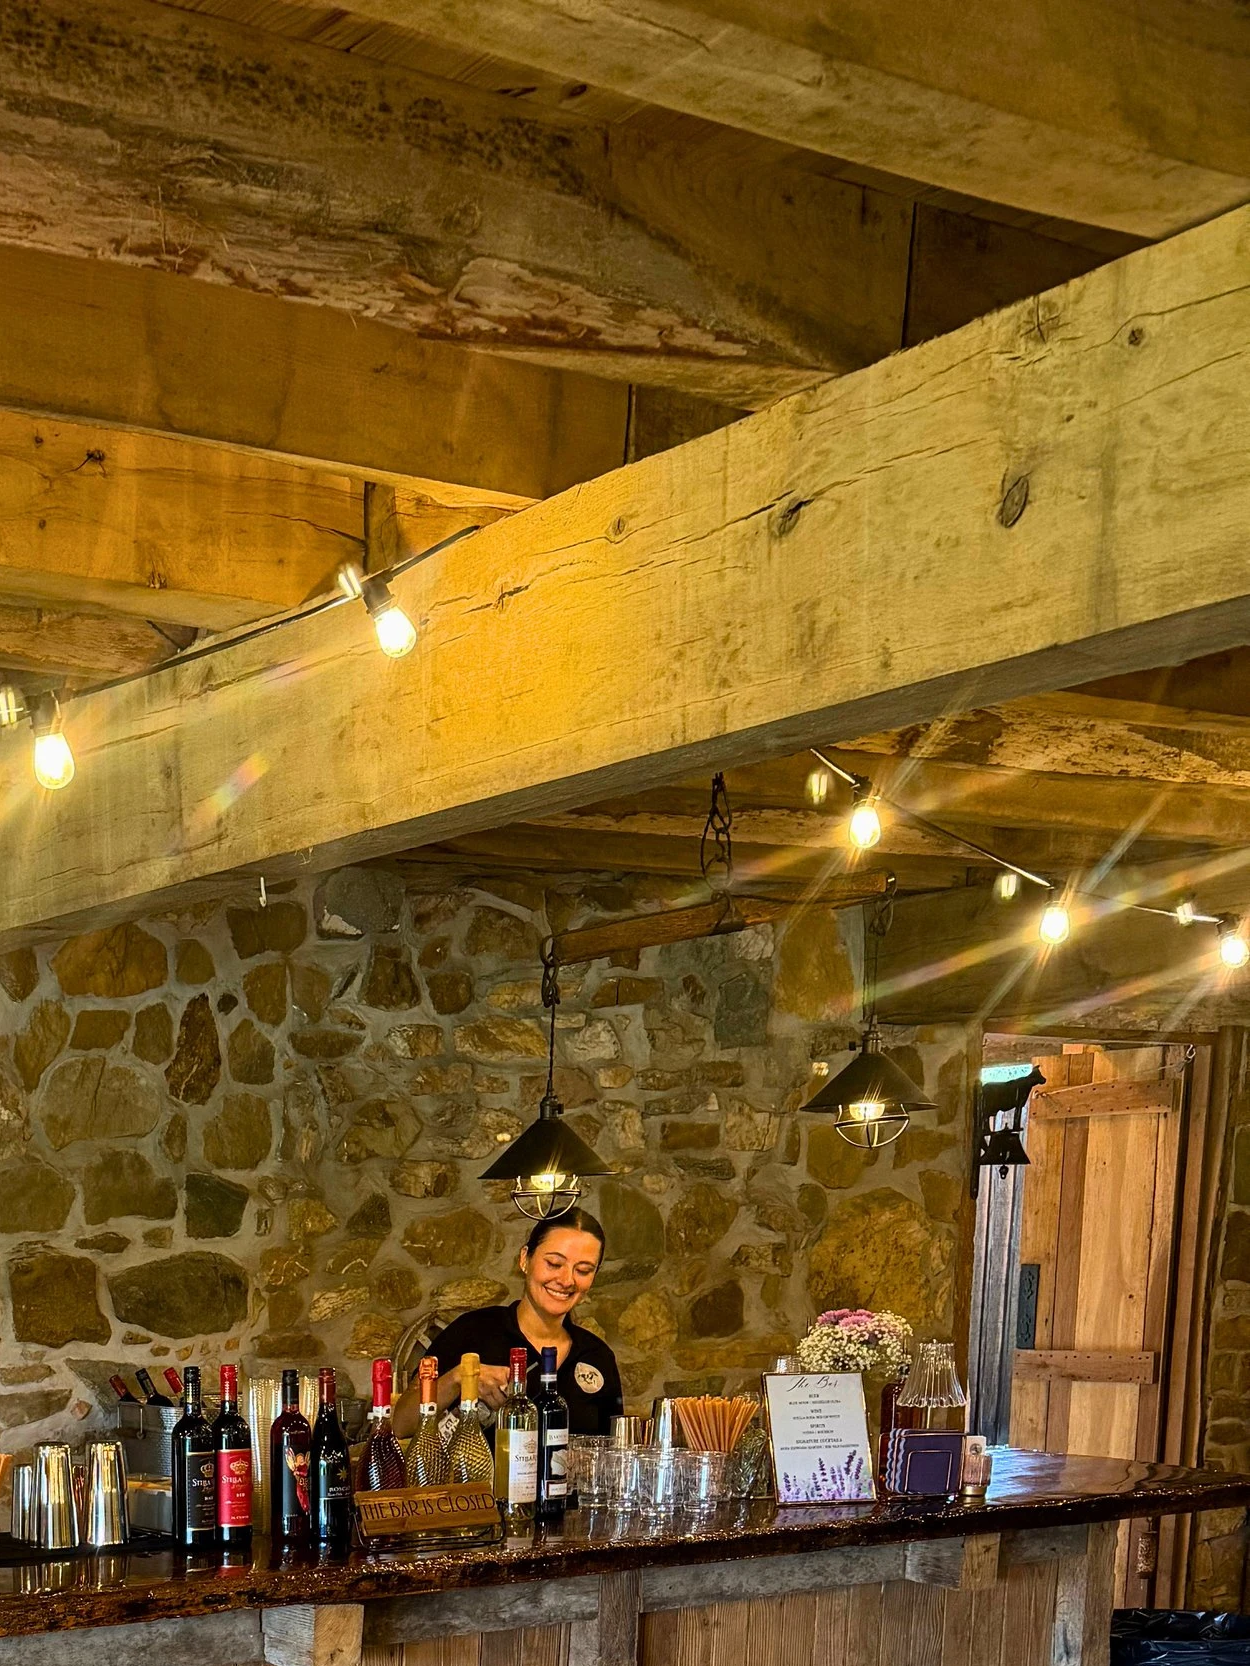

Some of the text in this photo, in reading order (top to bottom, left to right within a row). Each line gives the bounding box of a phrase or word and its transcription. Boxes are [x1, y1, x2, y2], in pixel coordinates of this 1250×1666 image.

[786, 1375, 838, 1392] The Bar
[360, 1493, 495, 1520] THE BAR IS CLOSED
